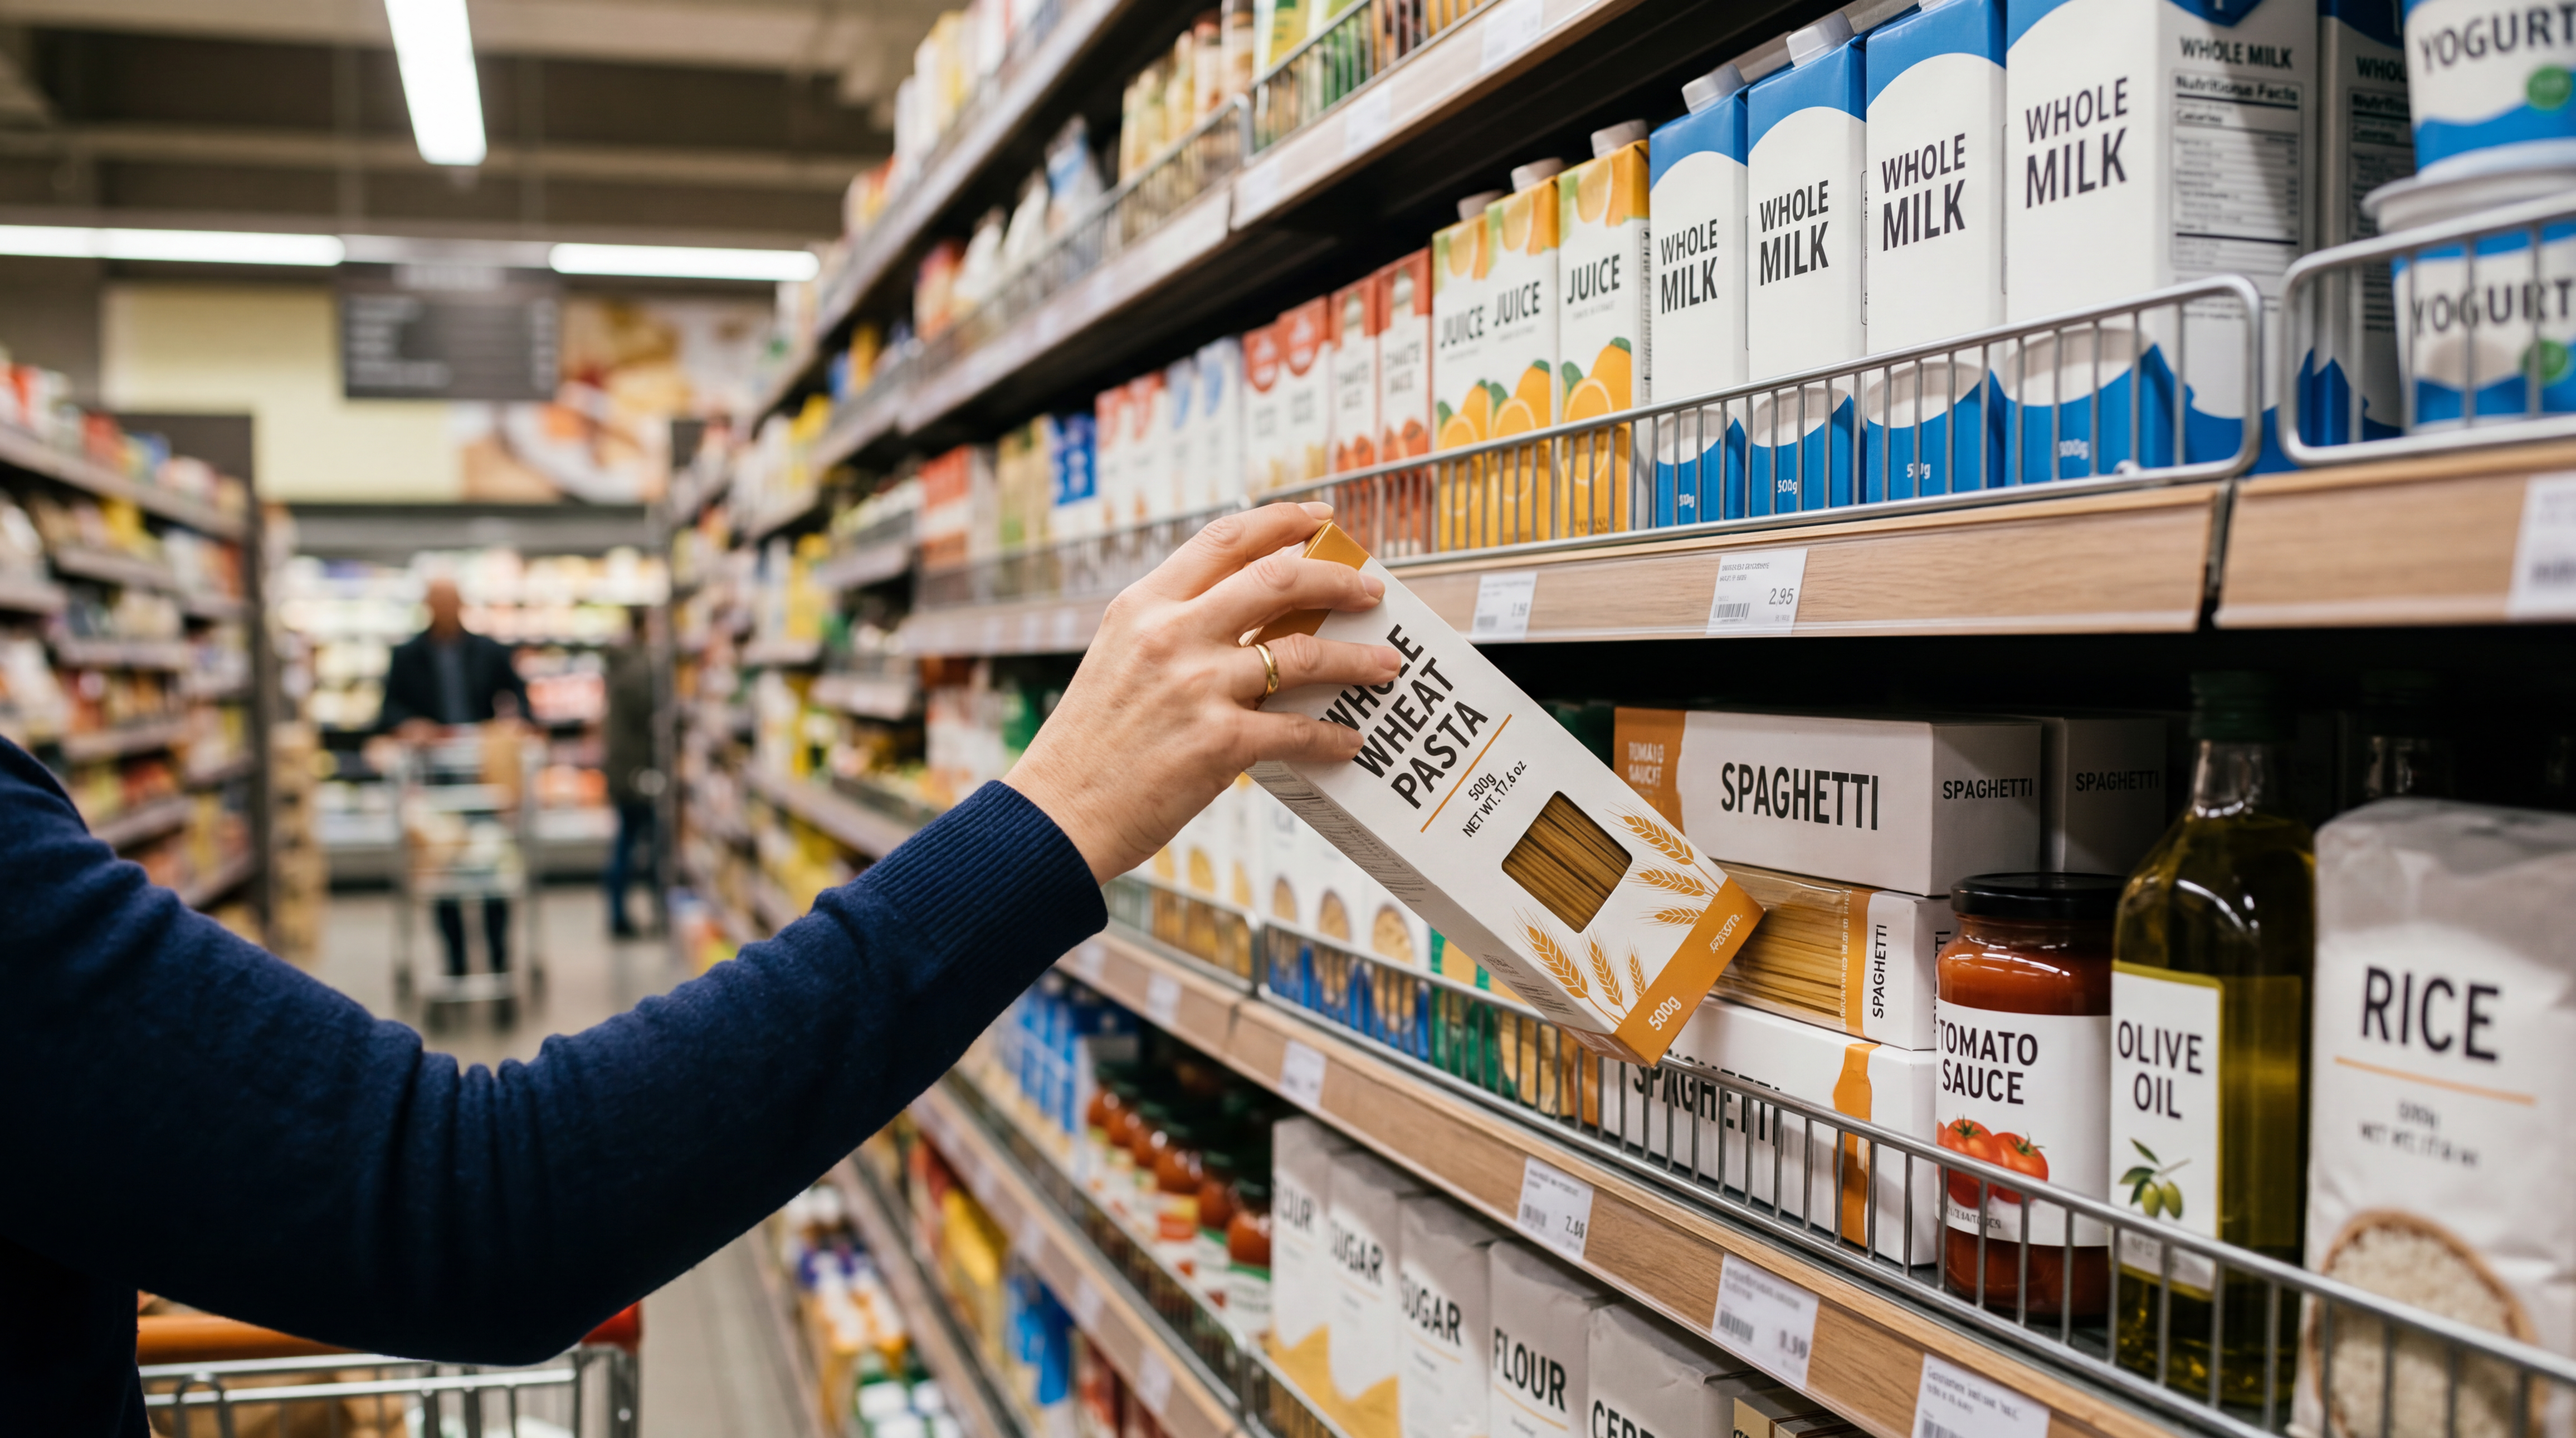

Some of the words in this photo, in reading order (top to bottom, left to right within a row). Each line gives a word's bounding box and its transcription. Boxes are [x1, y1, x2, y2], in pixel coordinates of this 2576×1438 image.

[2180, 37, 2243, 65] WHOLE
[2248, 44, 2292, 69] MILK
[2356, 55, 2408, 82] WHOL
[2420, 4, 2576, 75] YOGURT
[2026, 76, 2128, 144] WHOLE
[1881, 132, 1966, 194] WHOLE
[2026, 127, 2127, 209] MILK
[1760, 180, 1829, 233] WHOLE
[1883, 179, 1966, 252] MILK
[1661, 219, 1718, 266] WHOLE
[1760, 221, 1829, 286] MILK
[1494, 281, 1541, 327] JUICE
[1567, 254, 1621, 304] JUICE
[1661, 257, 1718, 315] MILK
[2411, 278, 2572, 337] YOGURT
[1440, 305, 1486, 349] JUICE
[1353, 657, 1454, 778] WHEAT
[1390, 701, 1488, 810] PASTA
[2075, 770, 2159, 792] SPAGHETTI
[1462, 812, 1484, 837] NET
[1478, 794, 1501, 815] WT.
[1513, 760, 1527, 776] oz
[1468, 773, 1496, 801] 500g
[1721, 762, 1878, 830] SPAGHETTI
[1943, 778, 2033, 800] SPAGHETTI
[1873, 924, 1887, 1019] SPAGHETTI
[1648, 996, 1682, 1031] 500g
[1939, 1019, 2038, 1066] TOMATO
[2362, 965, 2500, 1062] RICE
[2118, 1020, 2203, 1074] OLIVE
[1942, 1058, 2025, 1105] SAUCE
[2134, 1072, 2182, 1119] OIL
[1401, 1271, 1461, 1347] SUGAR
[1493, 1327, 1566, 1413] FLOUR
